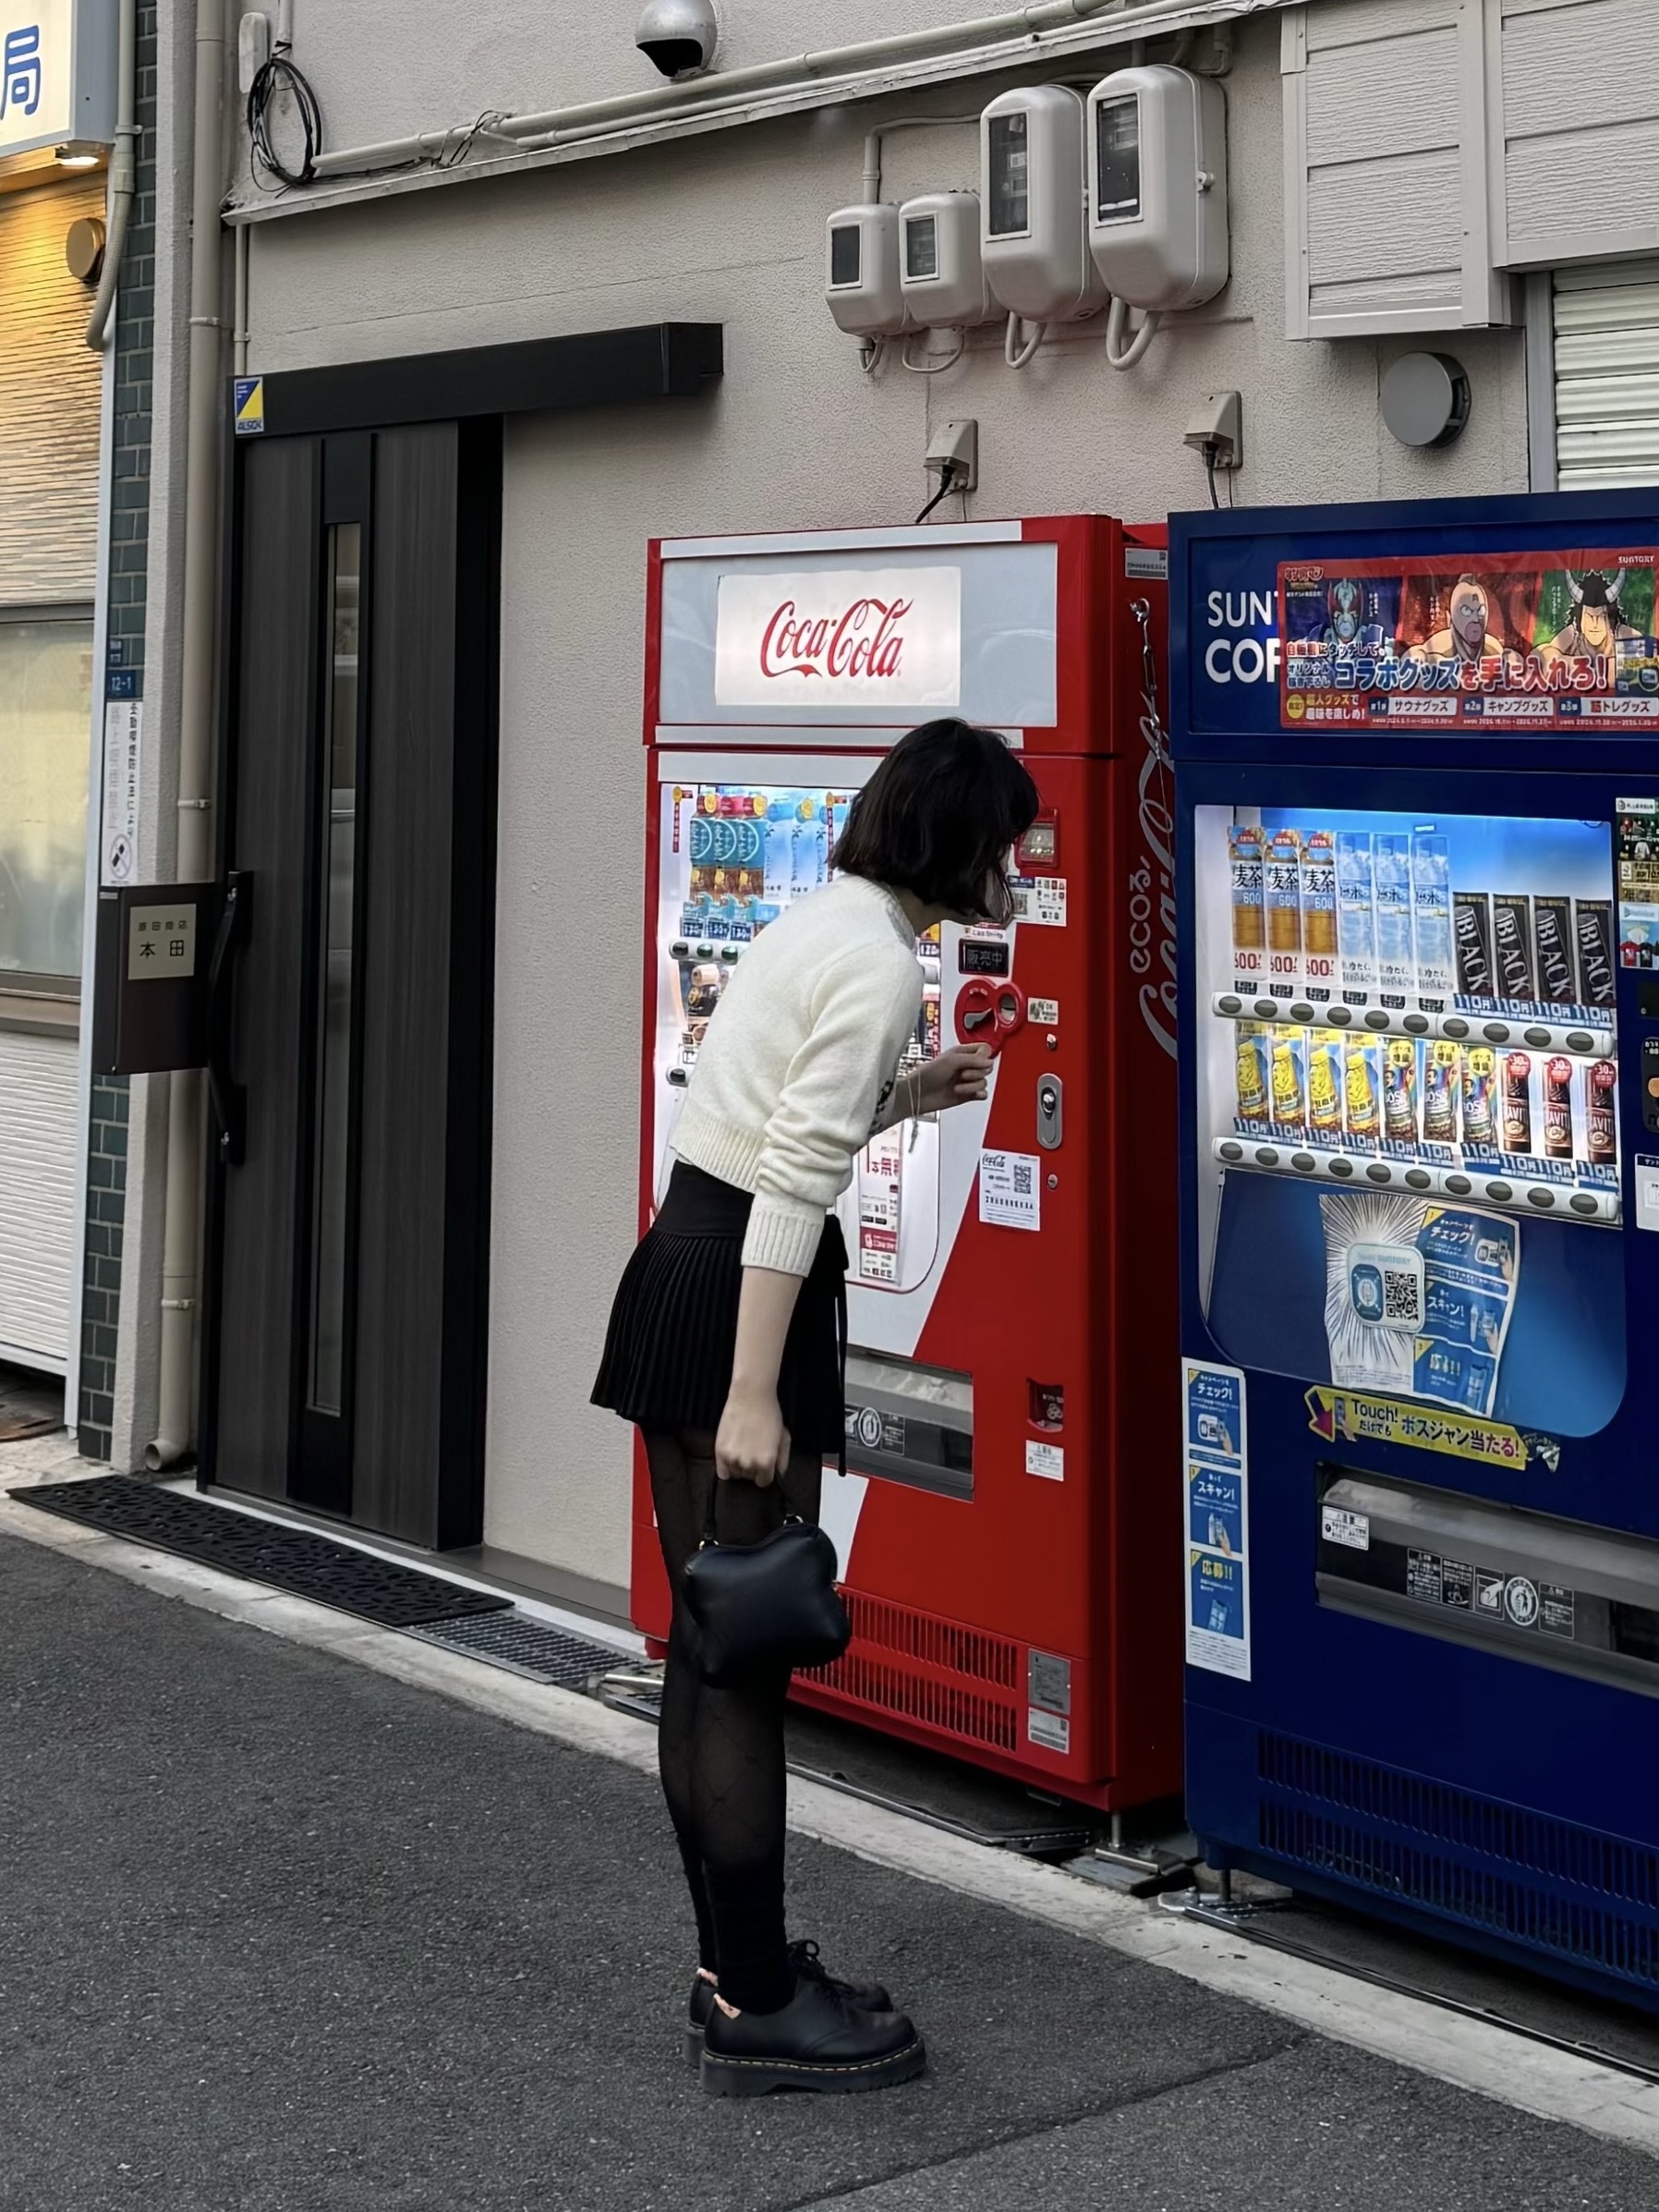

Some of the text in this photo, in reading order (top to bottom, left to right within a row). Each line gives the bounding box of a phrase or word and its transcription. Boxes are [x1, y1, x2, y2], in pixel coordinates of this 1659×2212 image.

[1617, 555, 1654, 565] SUNTORY
[1207, 590, 1278, 627] SUN
[759, 598, 914, 678] Coca-Cola
[1395, 699, 1448, 712] サウナグッズ
[1488, 700, 1549, 712] キャンプグッズ
[139, 940, 185, 959] 本田
[1456, 916, 1491, 991] BLACK
[1496, 918, 1532, 994] BLACK
[1537, 922, 1571, 997] BLACK
[1578, 925, 1615, 1002] BLACK
[1430, 1226, 1475, 1246] チェック!
[1427, 1294, 1465, 1318] スキャン!
[1197, 1382, 1233, 1401] チェック!
[1351, 1398, 1399, 1423] Touch!
[1401, 1416, 1520, 1458] ボスジャン当たる!
[1197, 1480, 1235, 1501] スキャン!
